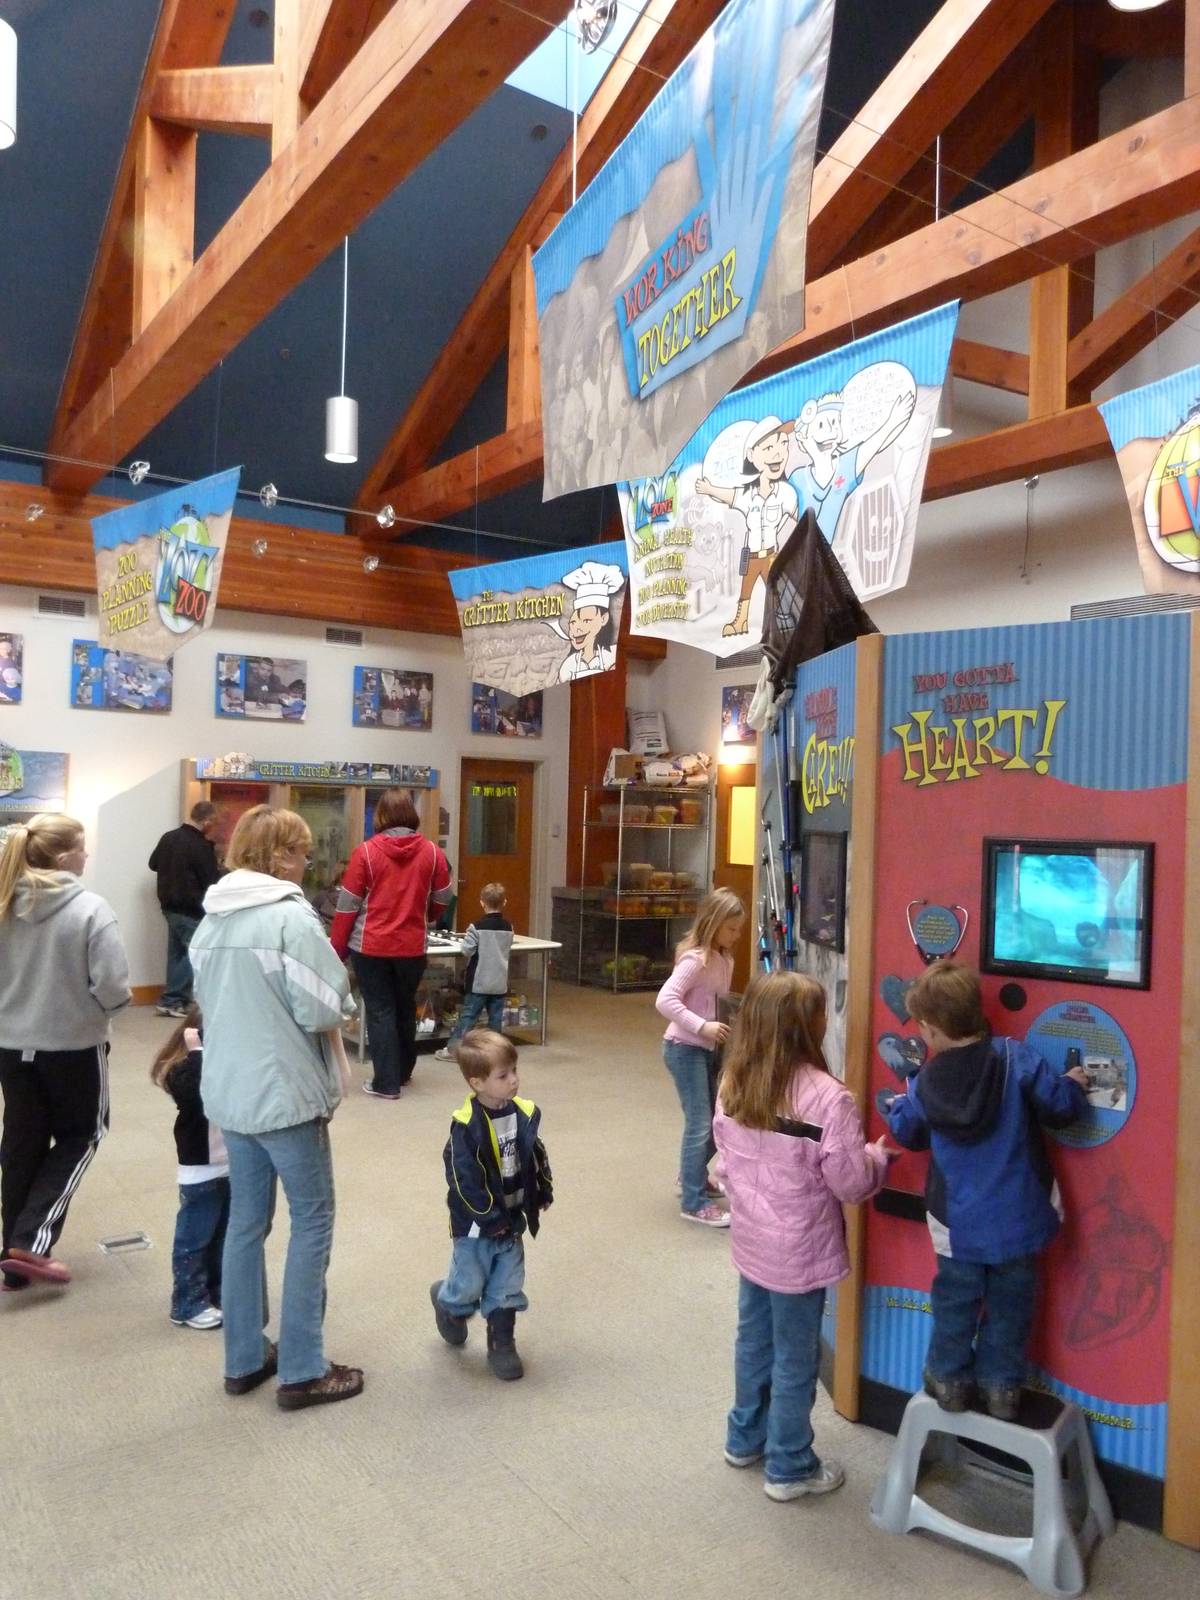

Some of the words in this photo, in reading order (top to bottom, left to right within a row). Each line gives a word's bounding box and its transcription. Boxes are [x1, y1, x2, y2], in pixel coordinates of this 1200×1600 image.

[623, 214, 709, 328] WORKING
[639, 247, 743, 389] TOGETHER
[118, 551, 137, 578] ZOO
[102, 569, 153, 611] PLANNING
[175, 579, 207, 621] ZOO
[108, 602, 150, 637] PUZZLE
[463, 602, 511, 627] CRITTER
[515, 593, 565, 620] KITCHEN
[914, 671, 949, 693] YOU
[953, 662, 1021, 688] GOTTA
[943, 692, 990, 714] HAVE
[891, 699, 1067, 787] HEART!
